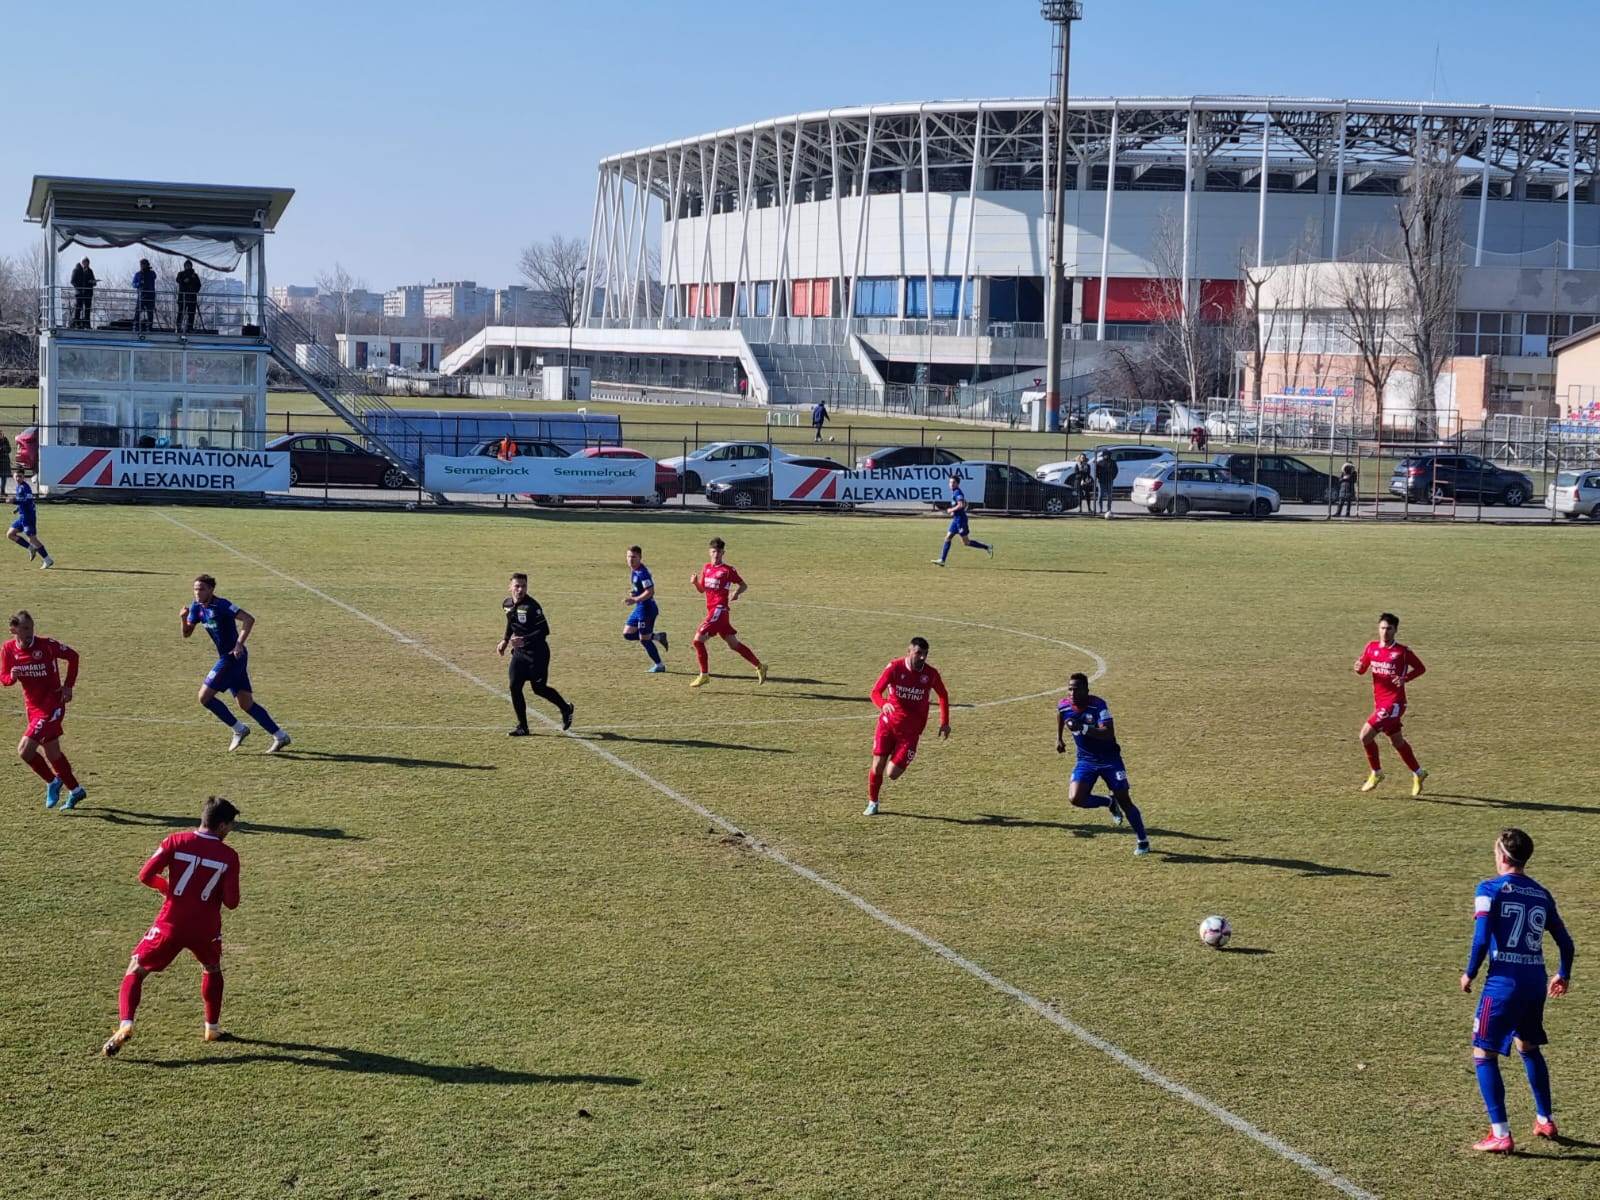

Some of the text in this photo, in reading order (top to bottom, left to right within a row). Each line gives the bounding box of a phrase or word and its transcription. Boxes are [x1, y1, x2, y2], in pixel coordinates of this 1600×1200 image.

[120, 449, 275, 468] INTERNATIONAL
[444, 465, 530, 477] Semmelrock
[553, 467, 636, 479] Semmelrock
[119, 472, 235, 490] ALEXANDER
[841, 486, 943, 501] ALEXANDER
[174, 851, 228, 901] 77
[1501, 901, 1547, 951] 79
